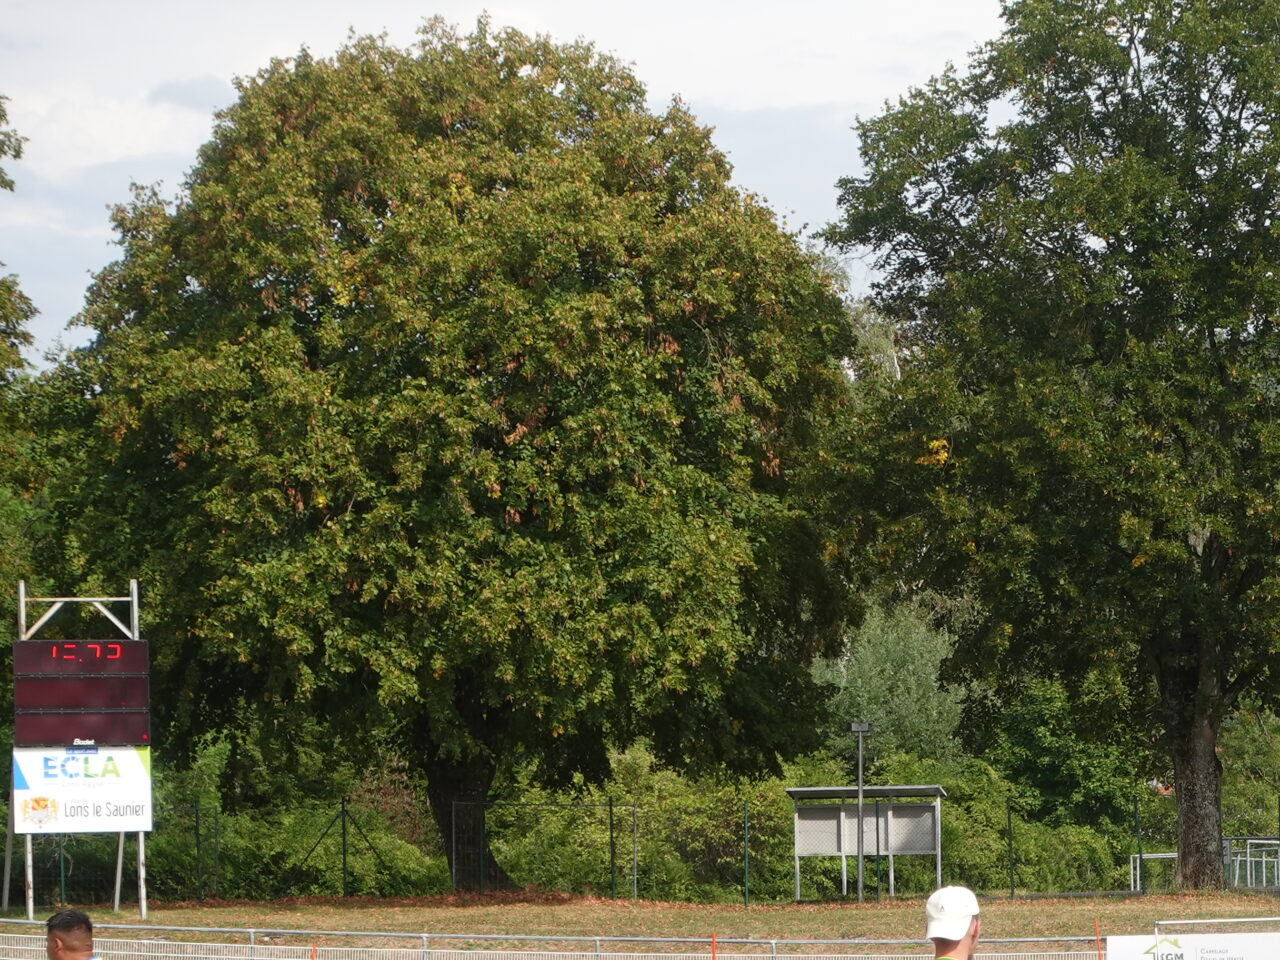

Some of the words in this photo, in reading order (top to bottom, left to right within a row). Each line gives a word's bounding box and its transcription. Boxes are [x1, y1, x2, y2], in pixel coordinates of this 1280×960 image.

[43, 756, 121, 778] ECLA
[64, 802, 89, 818] Lons
[93, 801, 102, 817] le
[105, 800, 145, 817] Saunier
